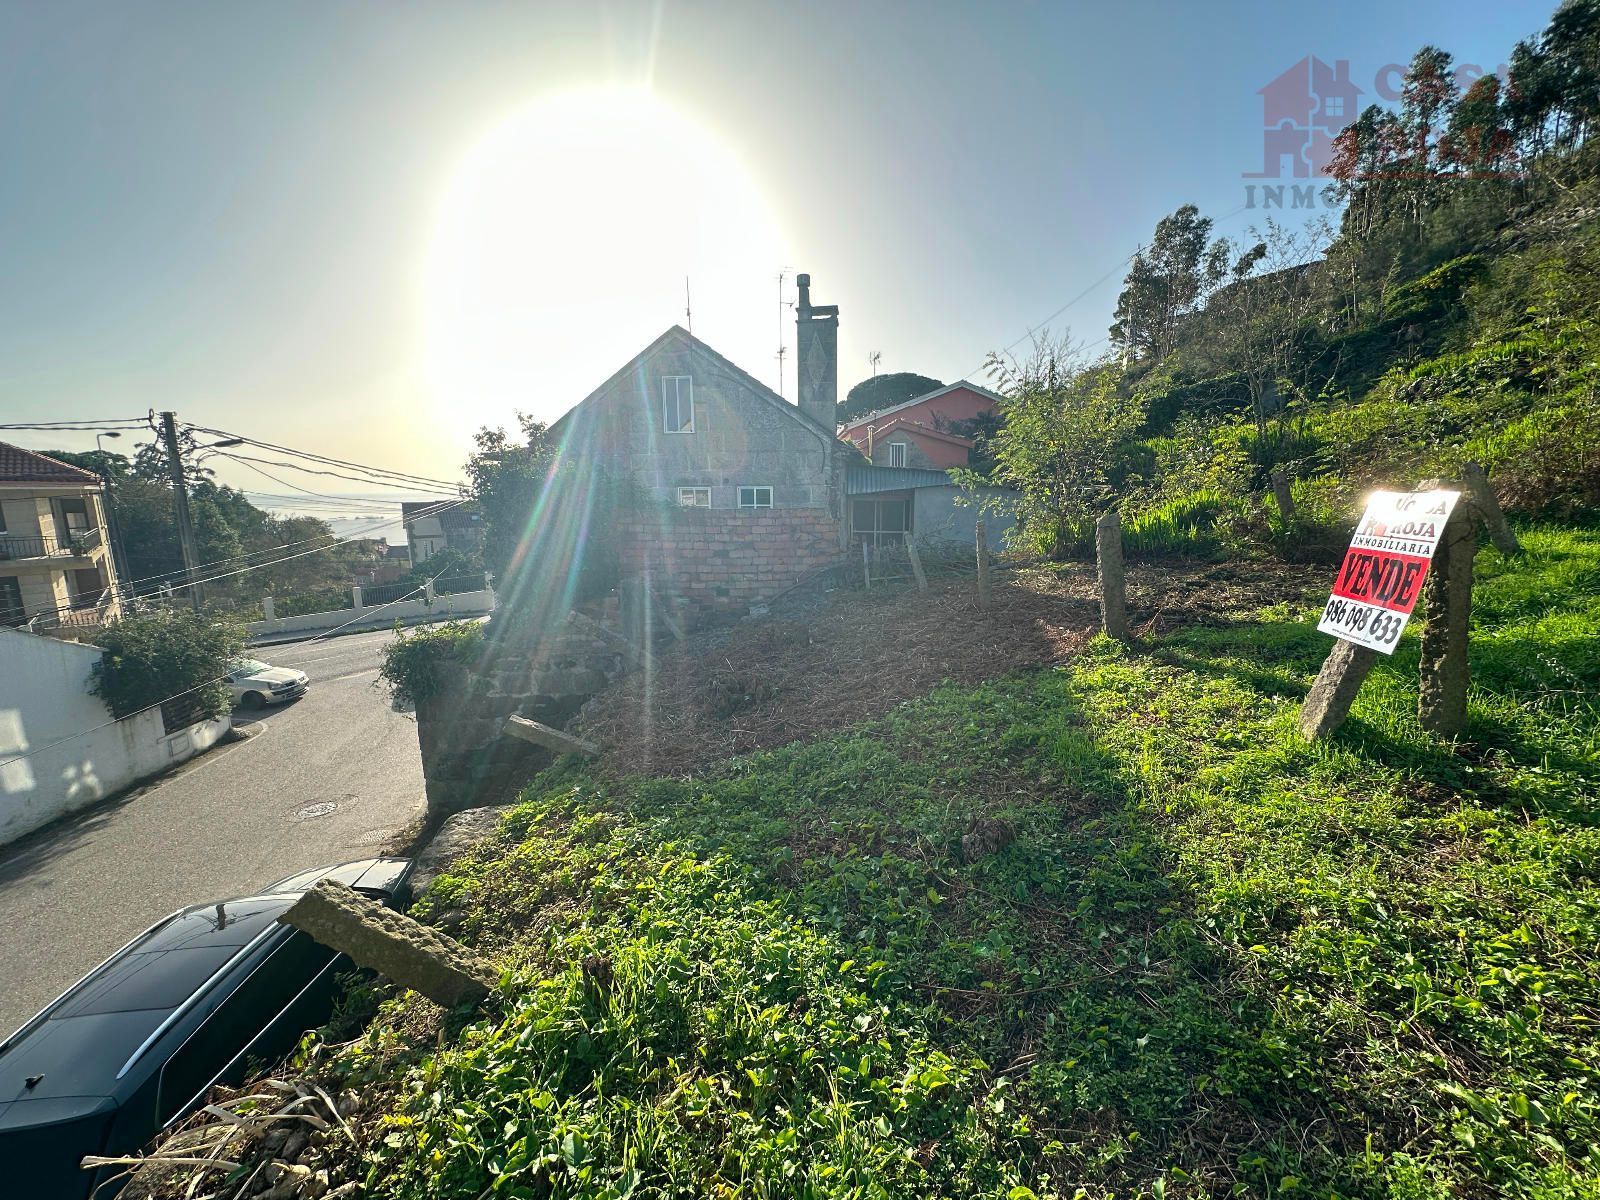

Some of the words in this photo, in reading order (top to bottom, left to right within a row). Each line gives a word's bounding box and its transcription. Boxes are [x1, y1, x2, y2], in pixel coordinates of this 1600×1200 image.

[1353, 536, 1431, 555] INMOBILIARIA
[1342, 553, 1421, 606] VENDE
[1323, 599, 1347, 624] 986
[1345, 607, 1372, 633] 098
[1369, 610, 1402, 644] 633
